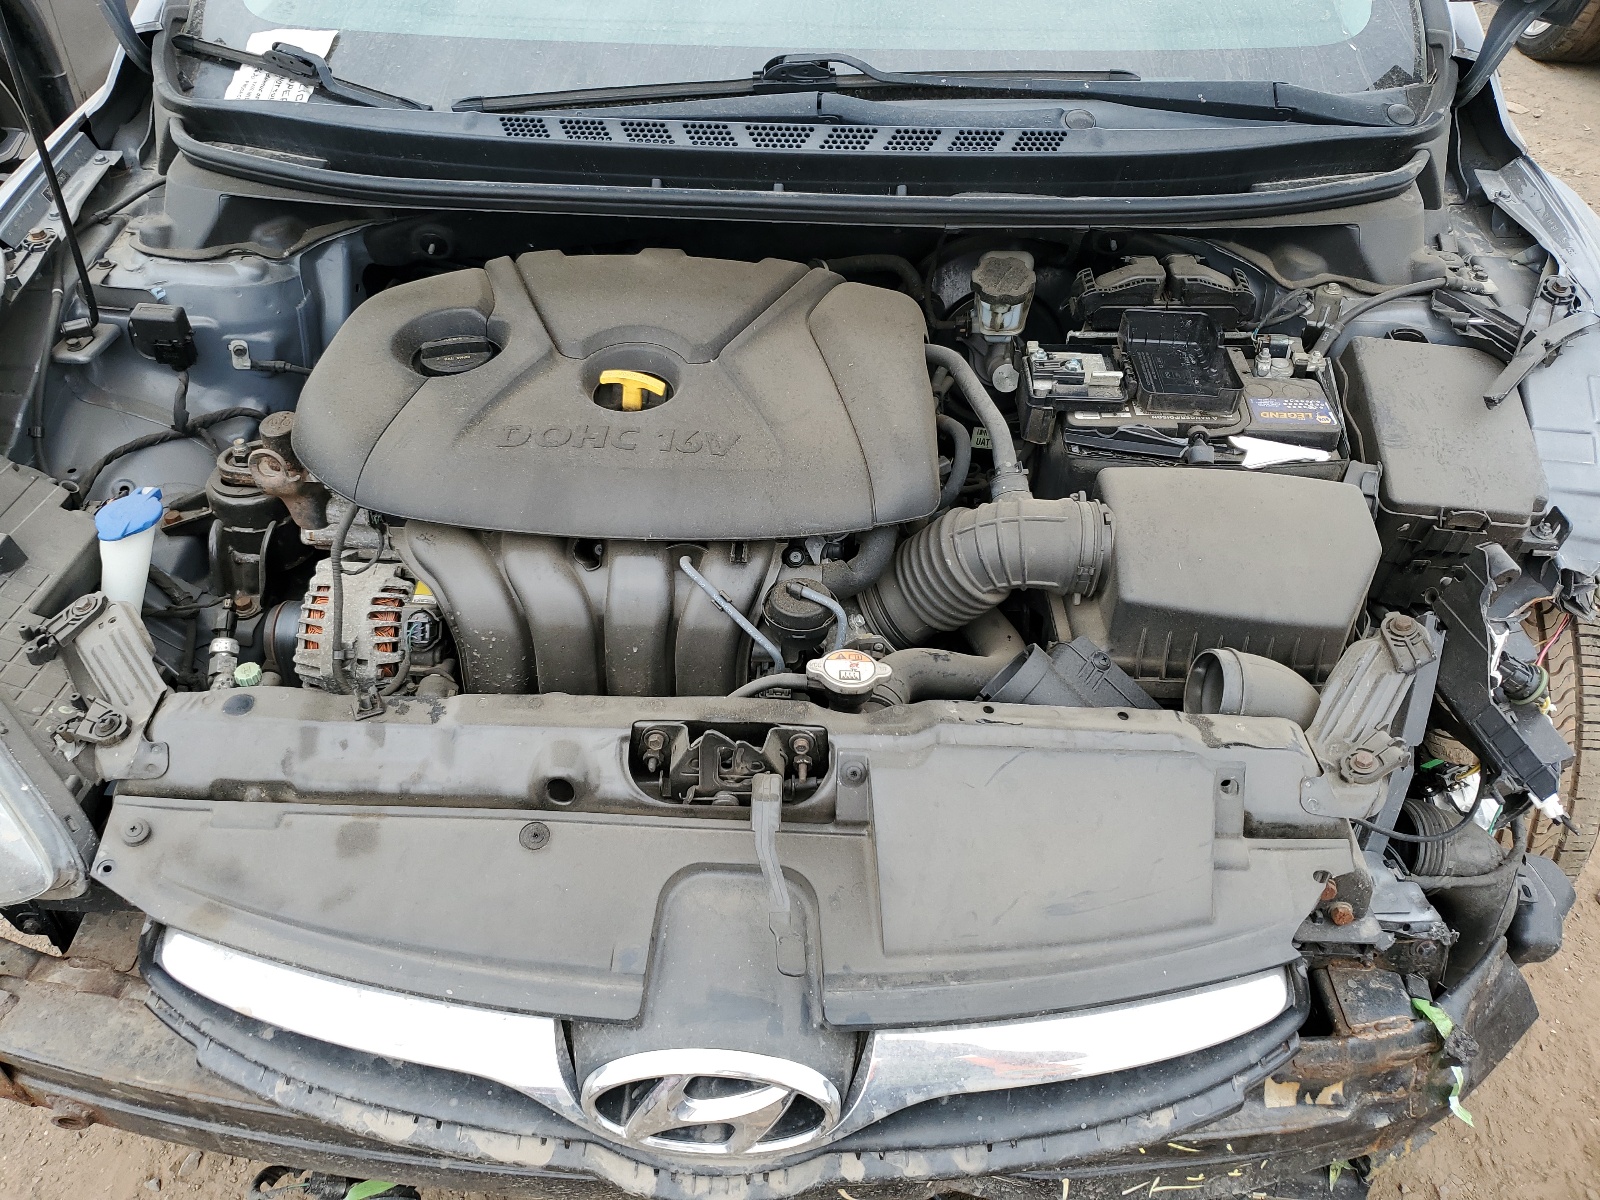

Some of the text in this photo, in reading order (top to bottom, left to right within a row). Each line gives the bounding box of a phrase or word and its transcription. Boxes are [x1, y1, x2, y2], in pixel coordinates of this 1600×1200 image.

[1260, 411, 1314, 420] LEGEND
[496, 424, 742, 457] DOHC 16V
